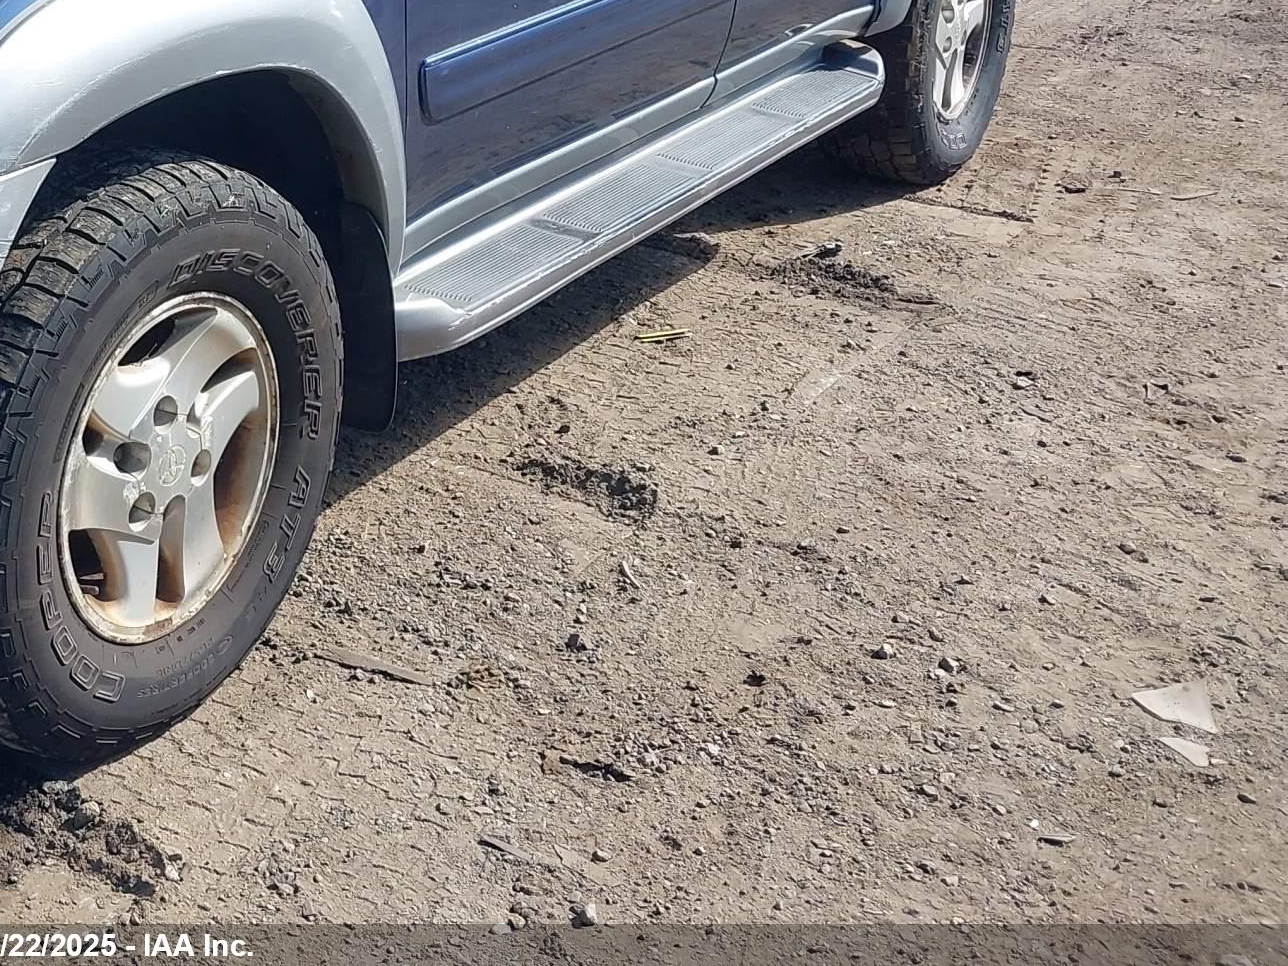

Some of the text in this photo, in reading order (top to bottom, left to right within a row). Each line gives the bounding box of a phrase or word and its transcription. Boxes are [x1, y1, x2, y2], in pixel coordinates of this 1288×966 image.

[167, 248, 323, 441] DISCOVERER
[263, 465, 311, 583] AT3
[36, 490, 126, 703] COOPER
